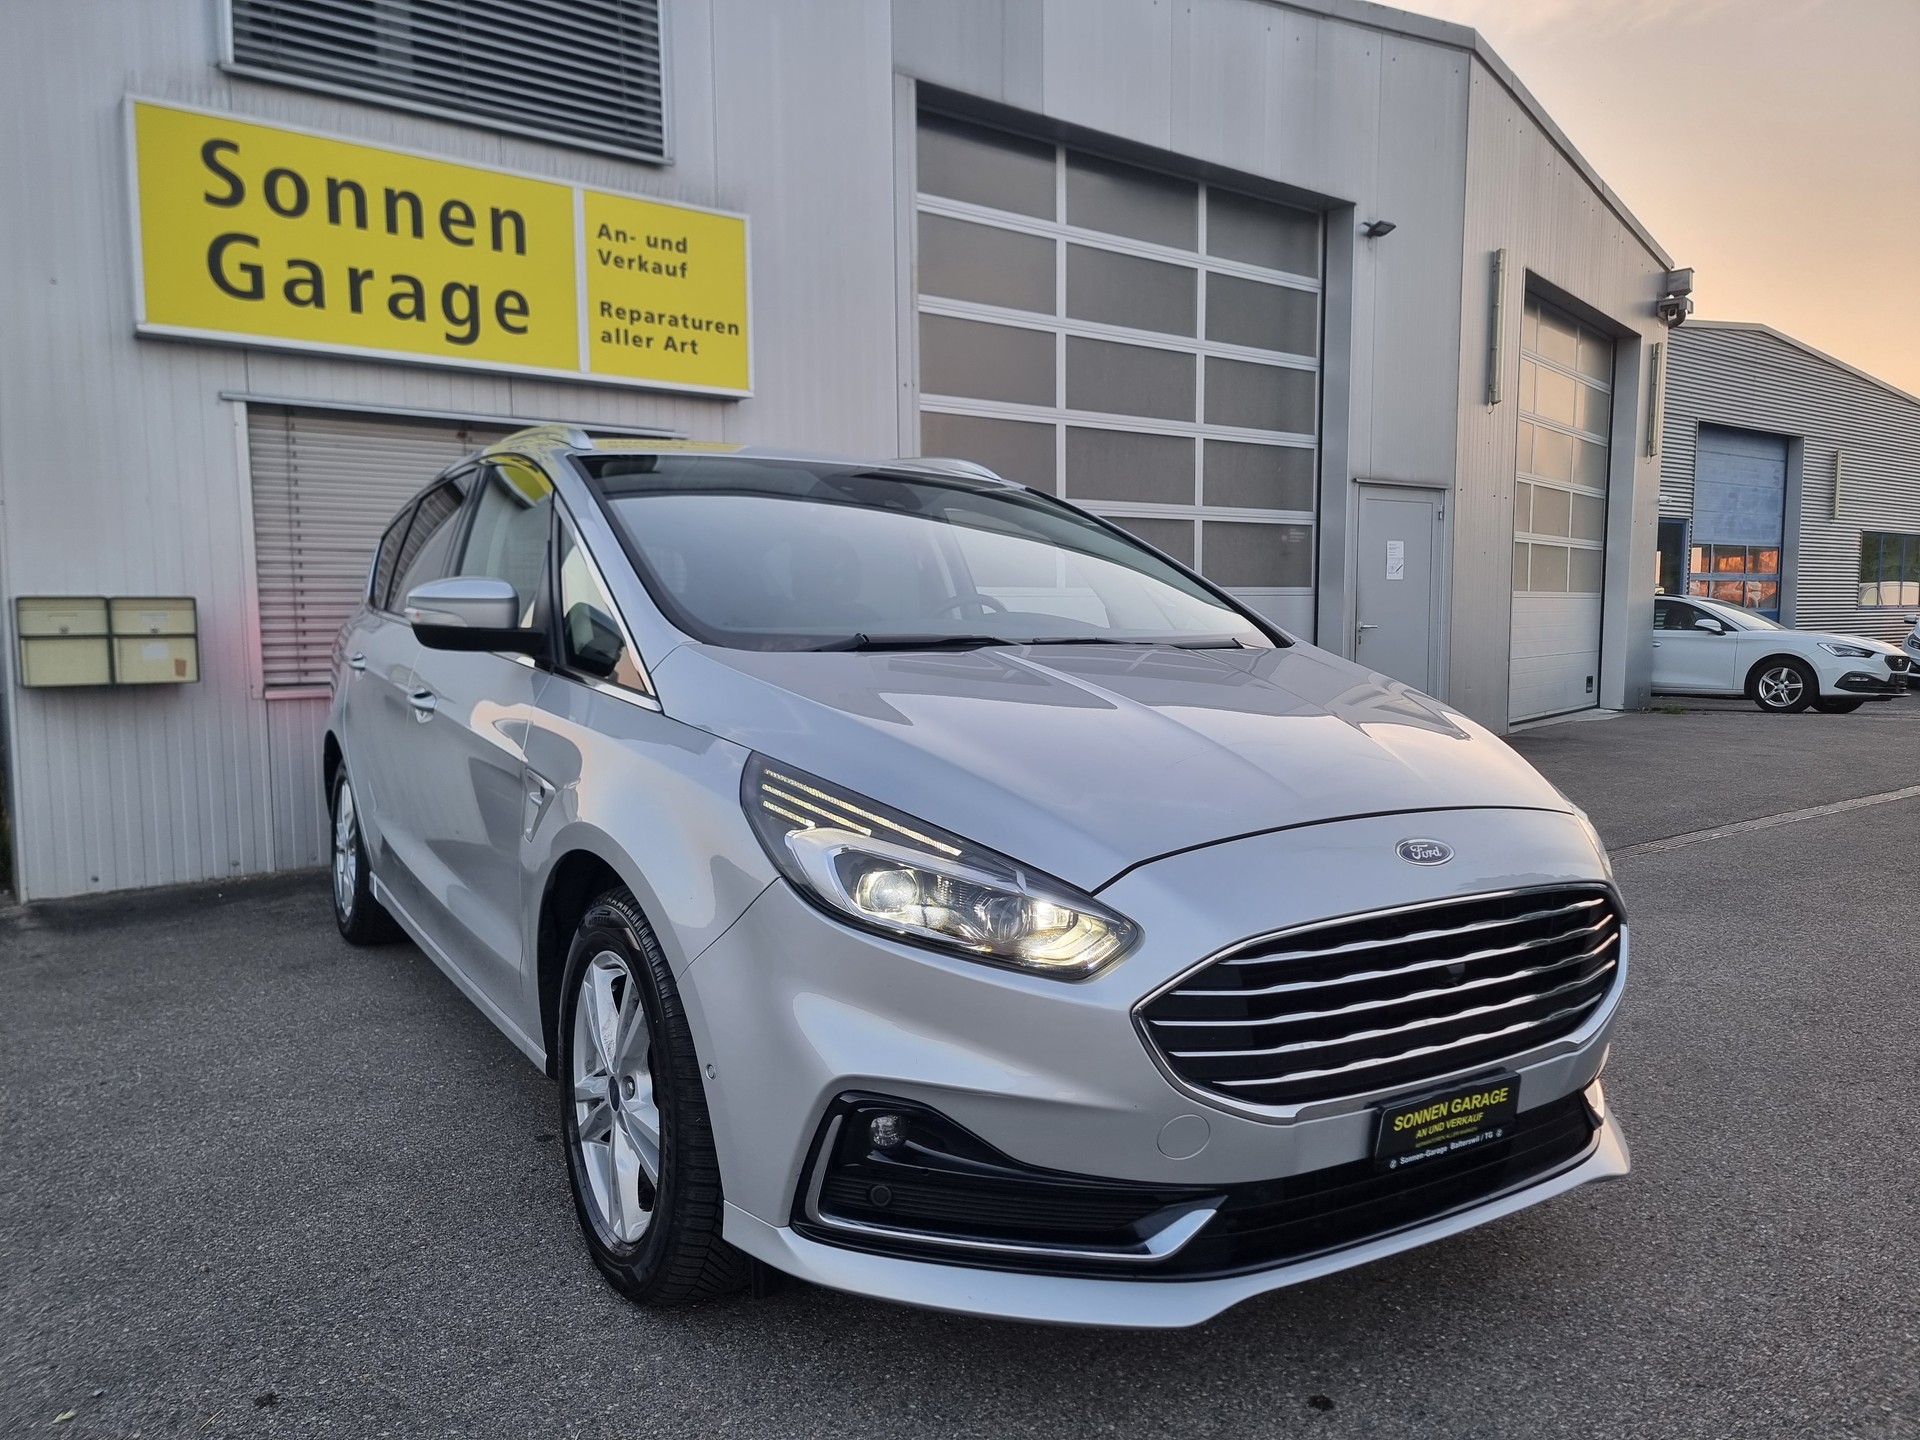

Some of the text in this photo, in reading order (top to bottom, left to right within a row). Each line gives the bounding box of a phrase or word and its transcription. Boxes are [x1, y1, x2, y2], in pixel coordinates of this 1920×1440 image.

[201, 138, 527, 256] Sonnen
[598, 223, 688, 254] An- und
[598, 249, 689, 279] Verkauf
[206, 232, 530, 346] Garage
[600, 301, 740, 336] Reparaturen
[601, 328, 699, 355] aller Art
[1410, 844, 1442, 860] Ford
[1393, 1087, 1509, 1131] SONNEN GARAGE
[1415, 1130, 1427, 1139] AN
[1428, 1122, 1445, 1134] UND
[1446, 1112, 1484, 1129] VERKAUF
